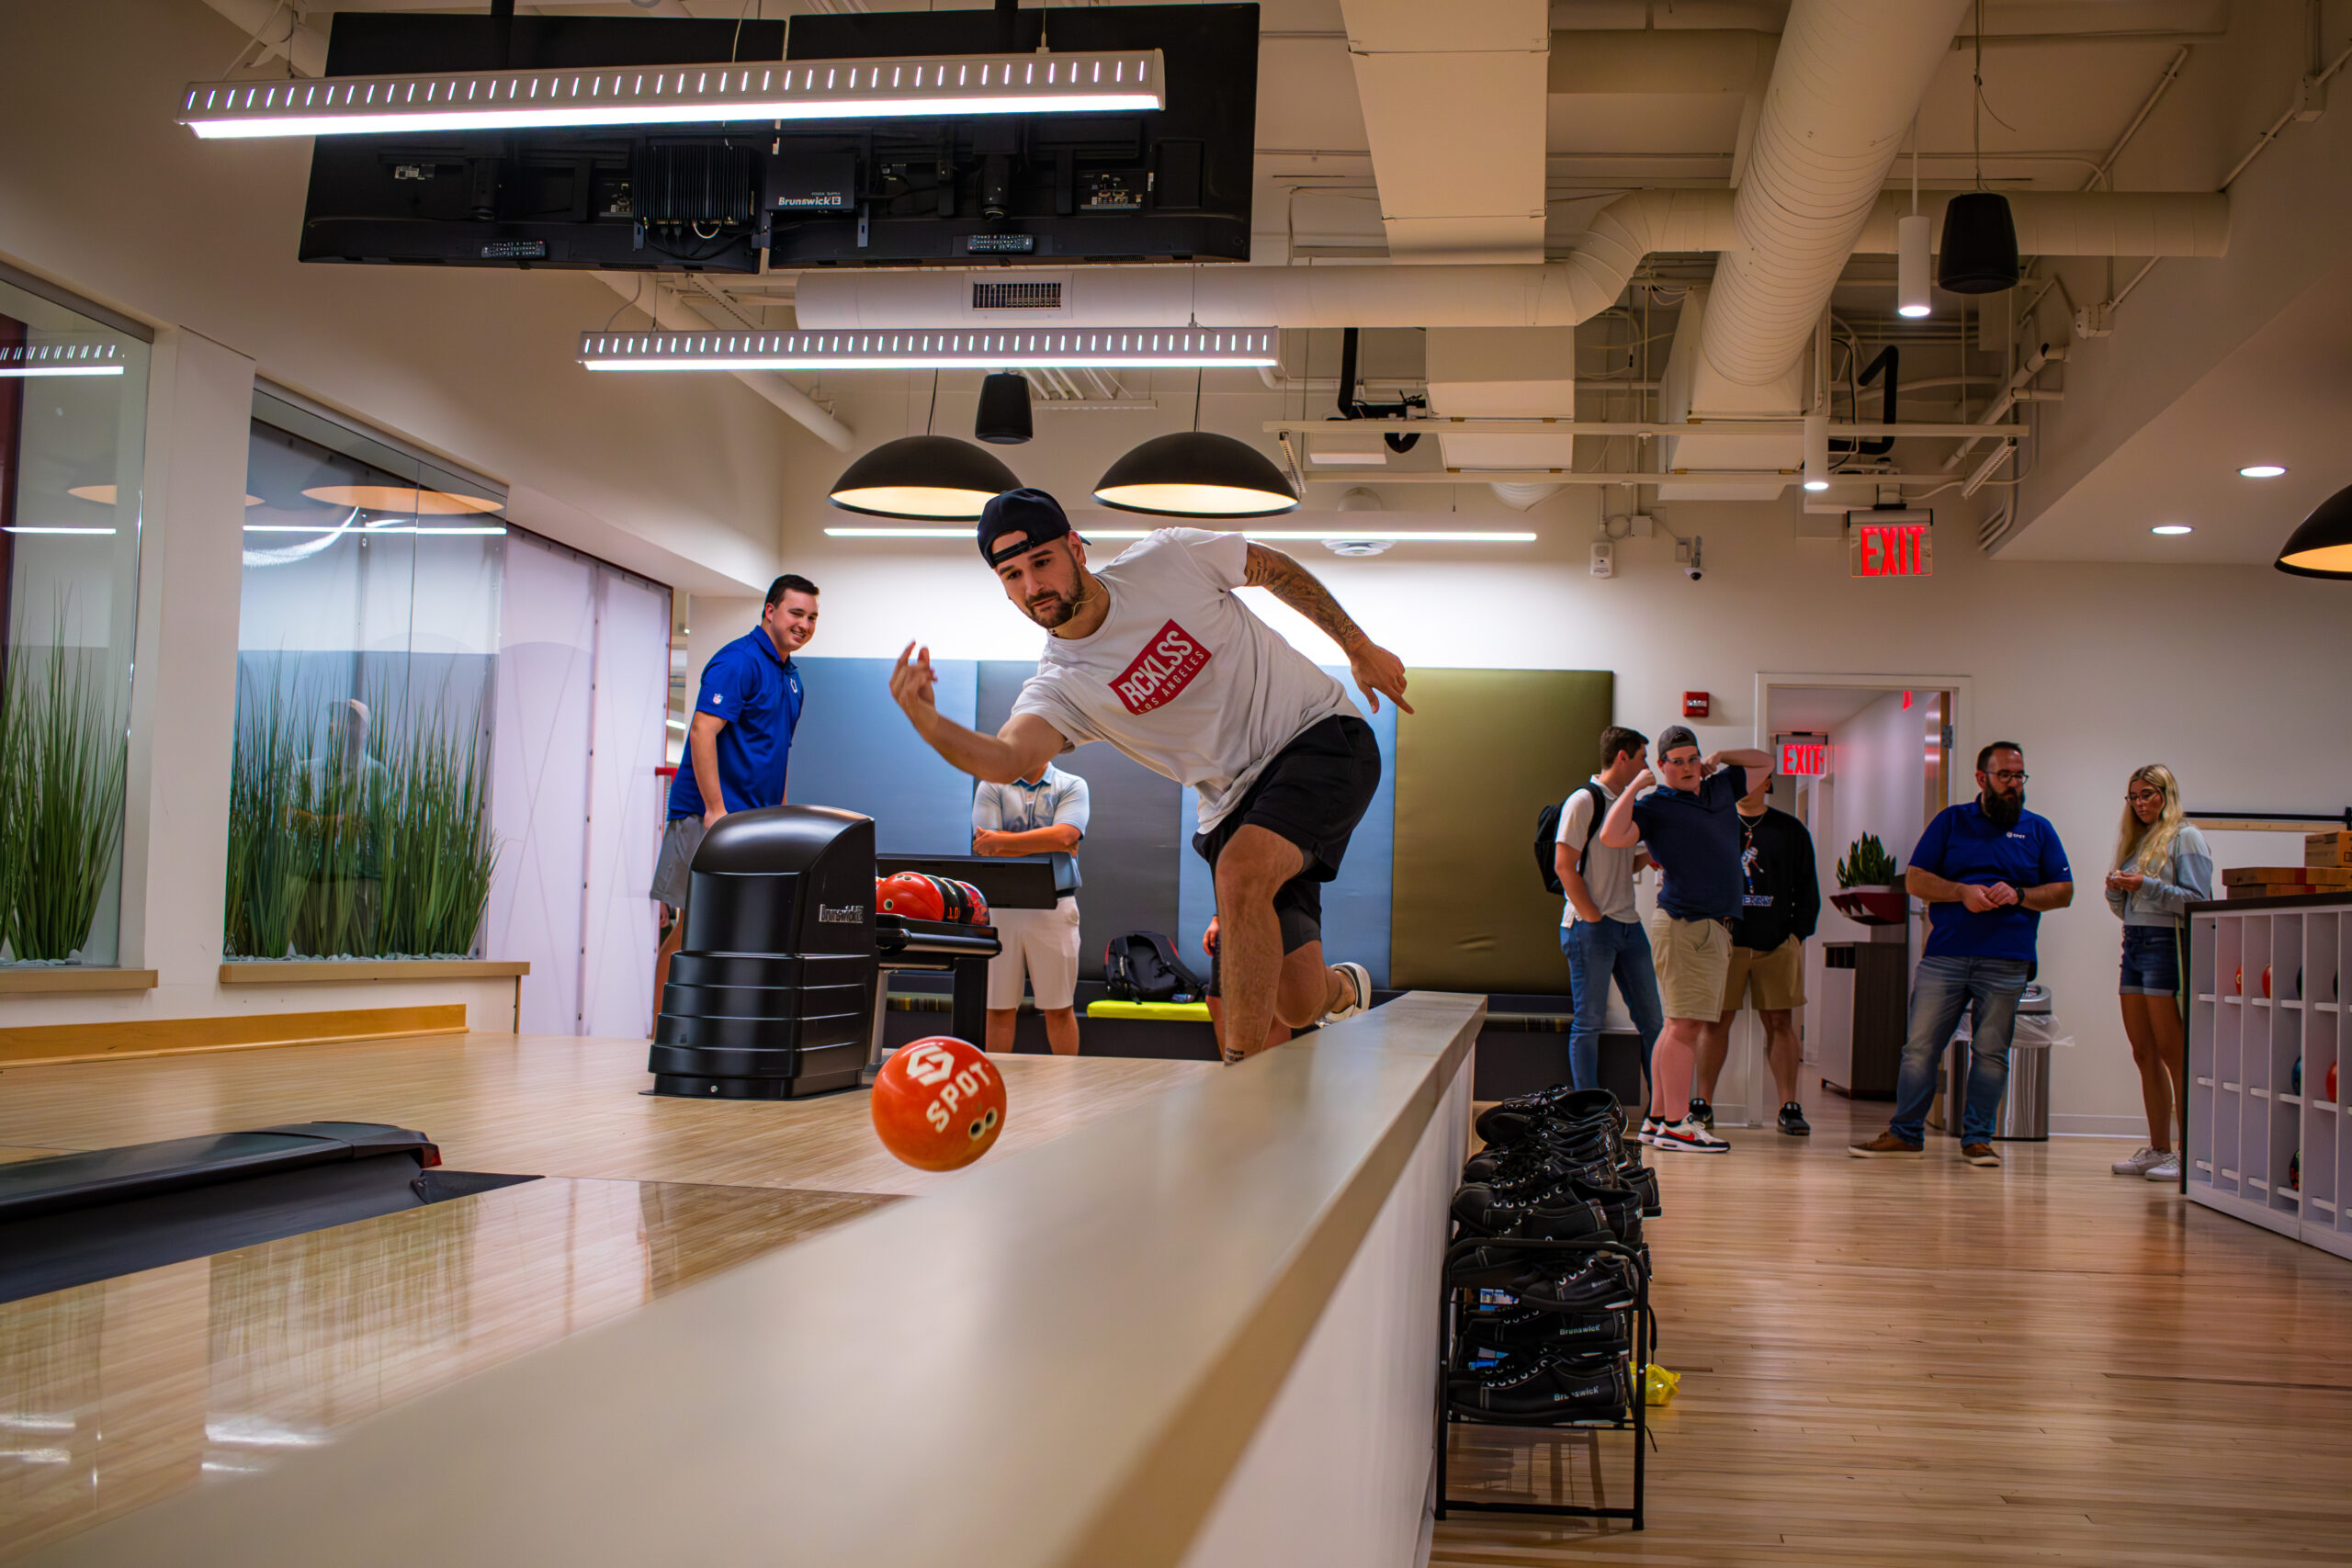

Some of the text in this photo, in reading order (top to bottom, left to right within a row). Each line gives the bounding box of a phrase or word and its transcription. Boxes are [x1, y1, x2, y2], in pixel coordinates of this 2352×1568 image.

[778, 196, 831, 206] Brunswick
[1861, 526, 1926, 576] EXIT
[1118, 630, 1193, 708] RCKLSS
[1137, 650, 1204, 713] LOS ANGELES
[1783, 745, 1823, 774] EXIT
[926, 1061, 990, 1134] SPOT
[1559, 1324, 1600, 1336] Brunswick
[1554, 1385, 1599, 1402] Bruswick
